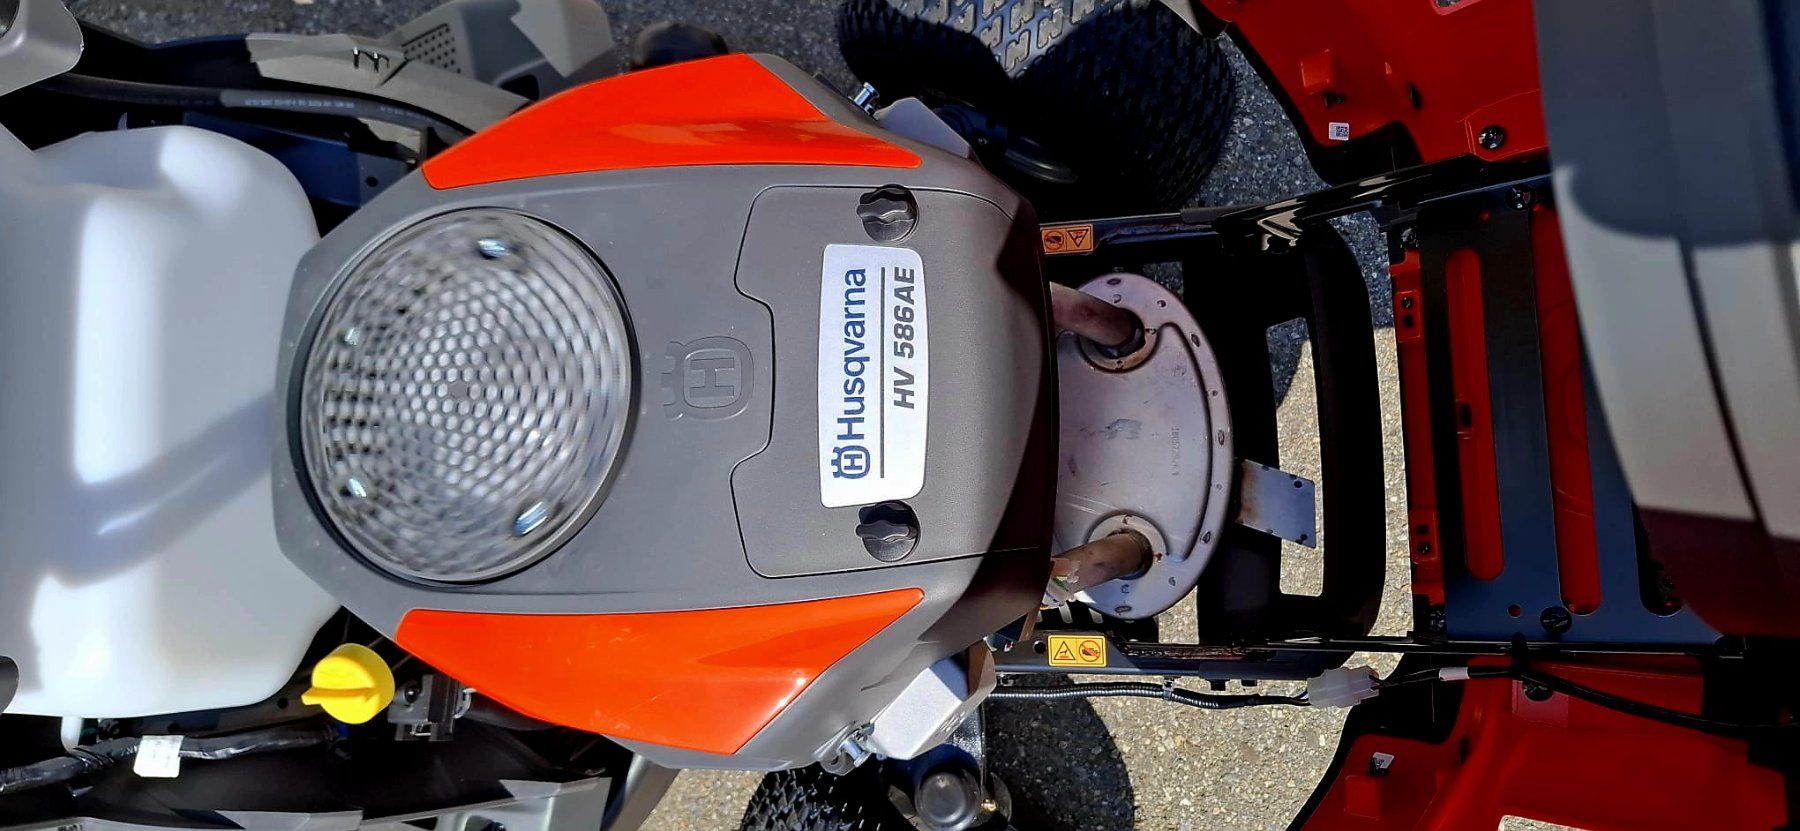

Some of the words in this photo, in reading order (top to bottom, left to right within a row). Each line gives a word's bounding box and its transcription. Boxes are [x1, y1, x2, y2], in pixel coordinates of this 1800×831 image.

[837, 268, 870, 440] Husqvarna
[893, 266, 915, 359] 586AE
[893, 366, 915, 409] HV
